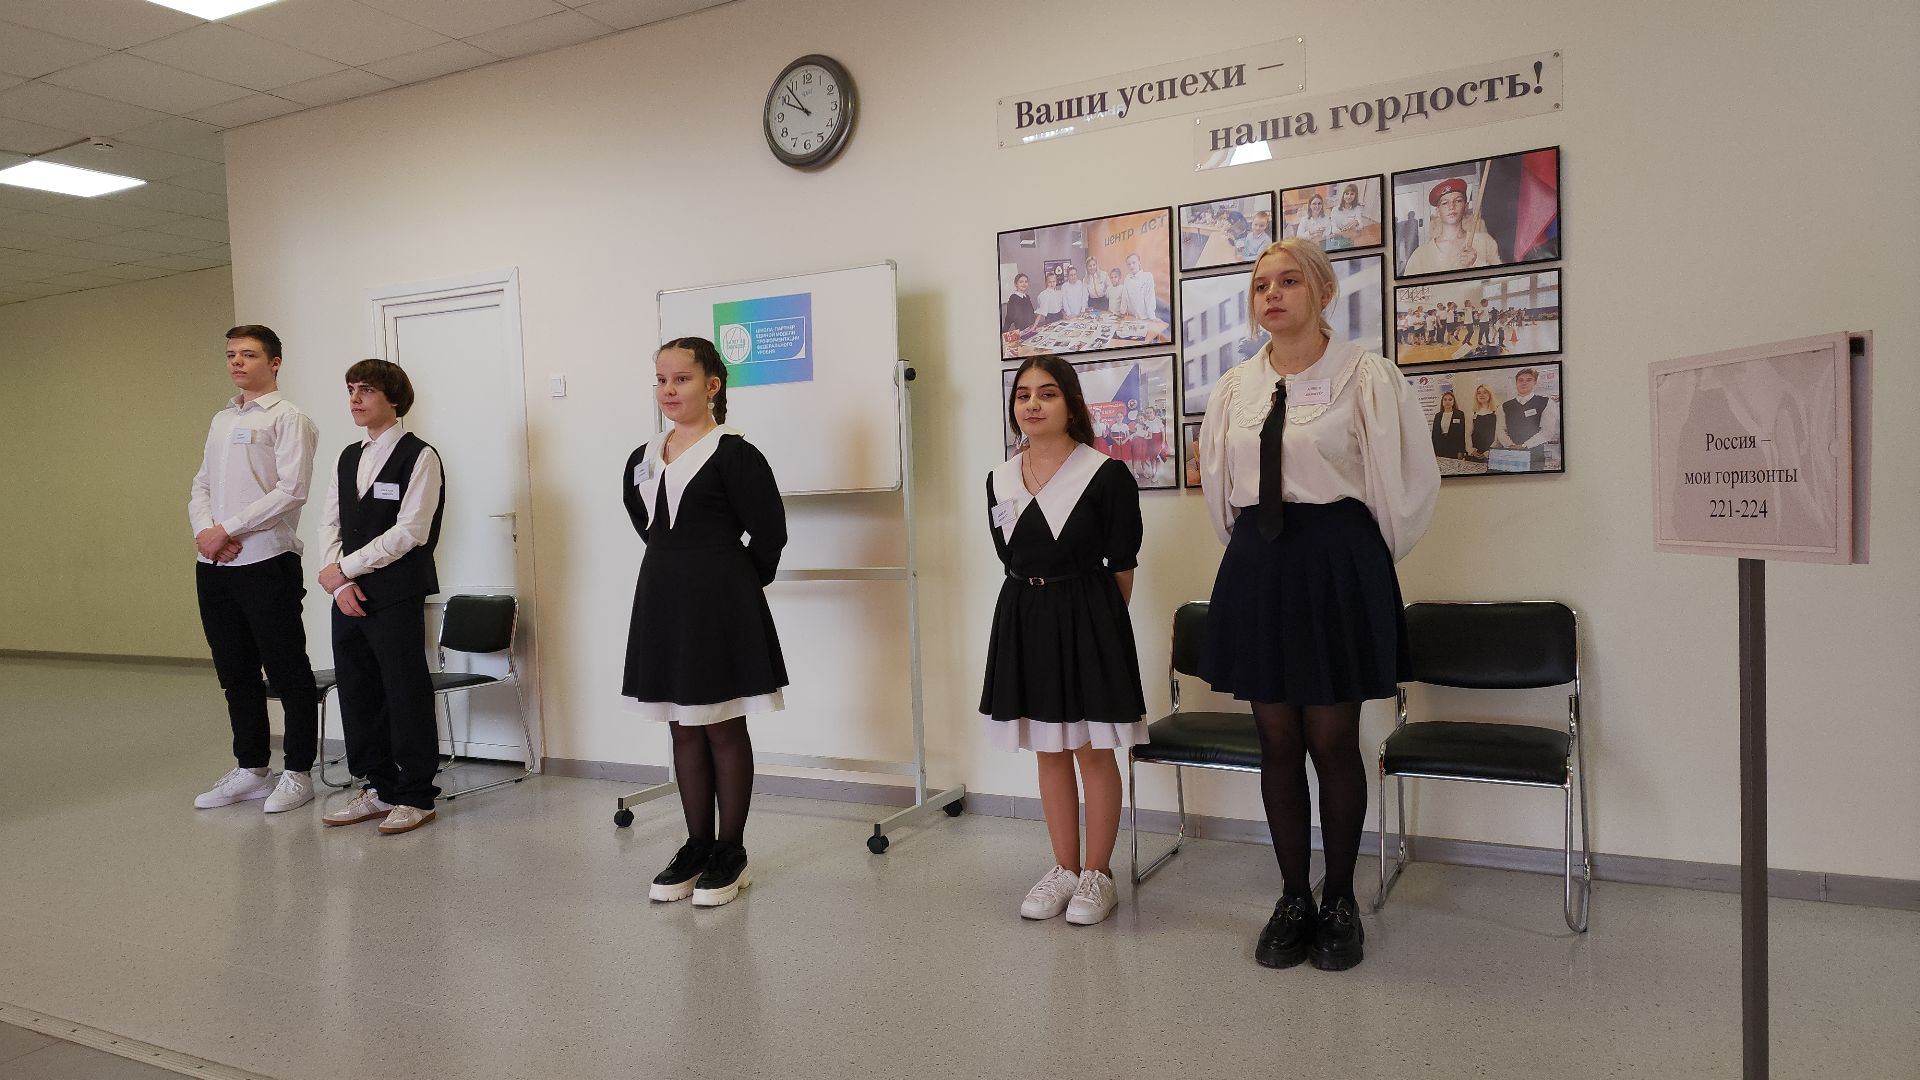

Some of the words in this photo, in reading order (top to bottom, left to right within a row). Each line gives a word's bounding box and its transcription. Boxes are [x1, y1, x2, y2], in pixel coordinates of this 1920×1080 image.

[802, 73, 813, 85] 12
[826, 84, 834, 96] 2
[1014, 91, 1109, 129] Ваши
[1117, 63, 1247, 118] успехи
[831, 100, 838, 111] 3
[1209, 111, 1318, 151] наша
[1329, 60, 1543, 133] гордость!
[777, 112, 785, 123] 9
[826, 118, 834, 128] 4
[781, 127, 789, 138] 8
[816, 132, 824, 143] 5
[791, 138, 798, 148] 7
[803, 139, 812, 150] 6
[1705, 433, 1756, 451] Россия
[1684, 471, 1711, 485] мои
[1715, 468, 1798, 488] горизонты
[1709, 499, 1768, 518] 221-224
